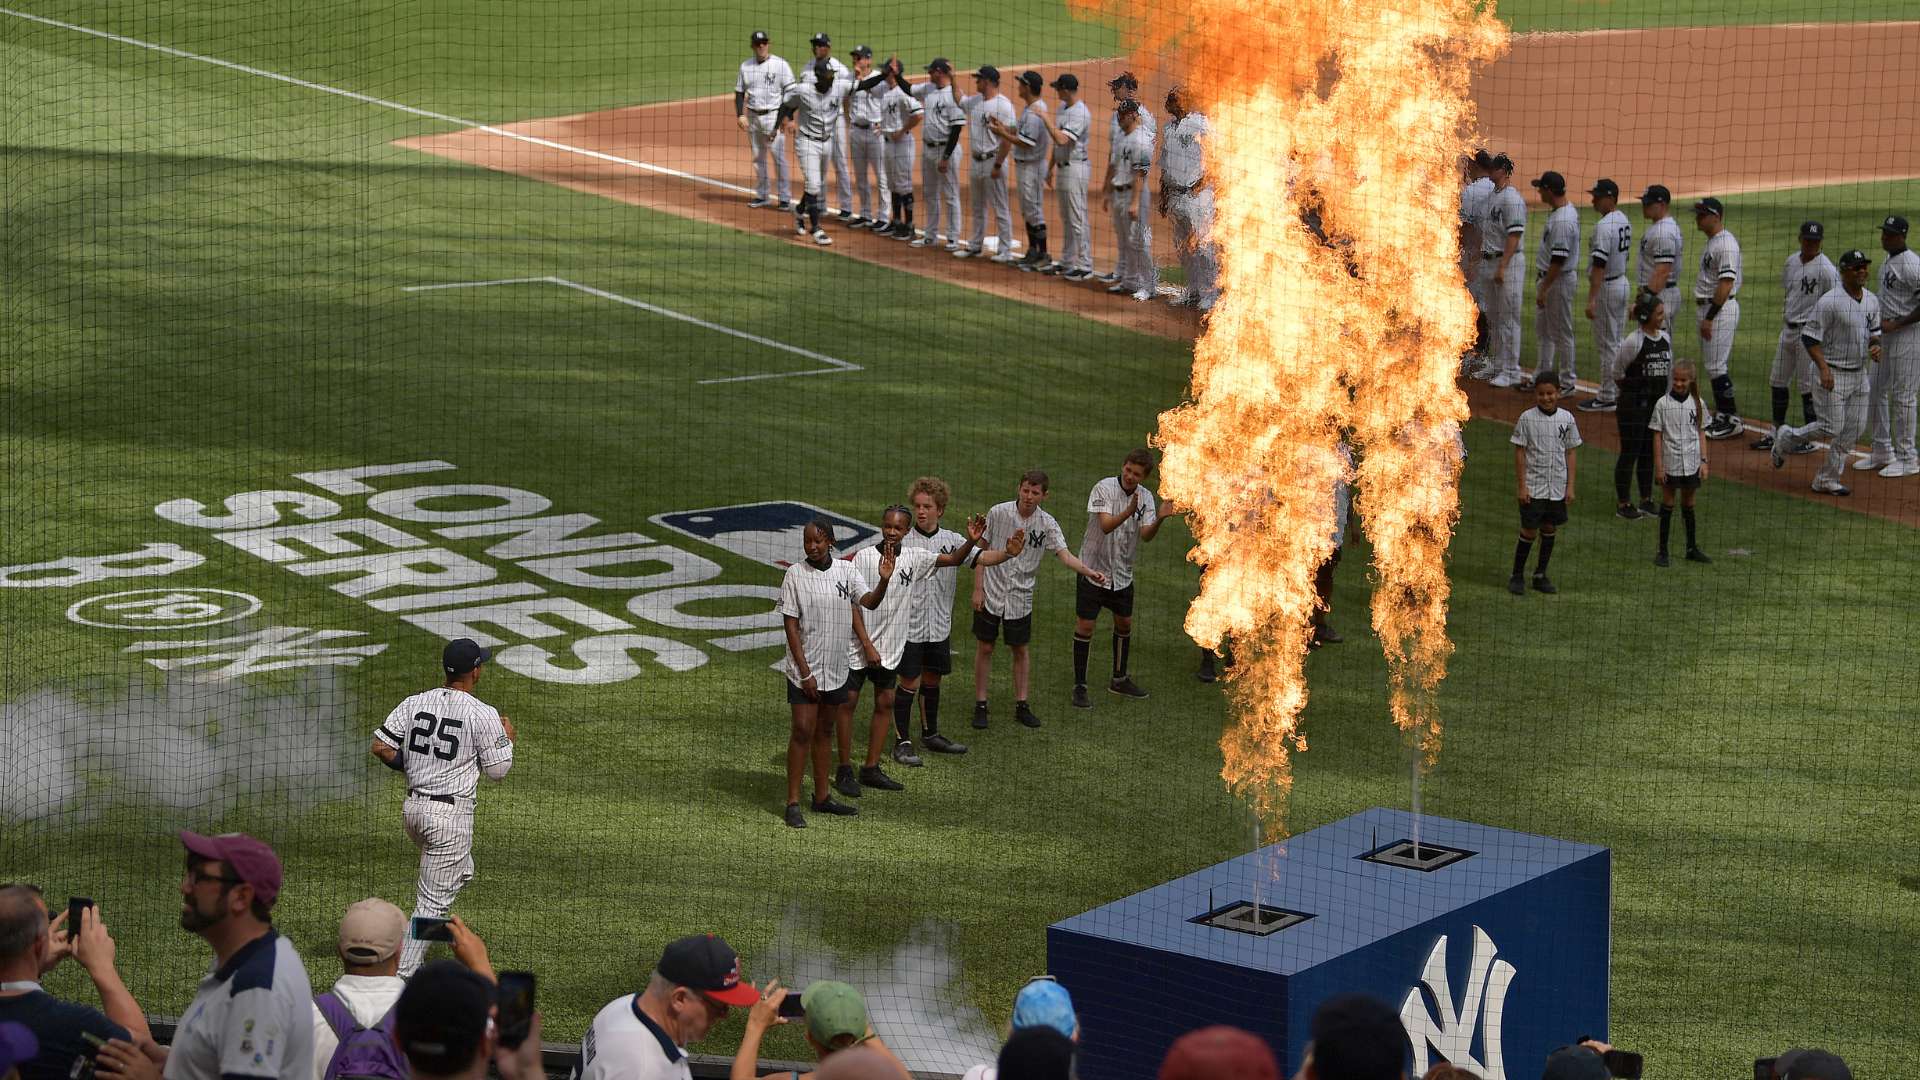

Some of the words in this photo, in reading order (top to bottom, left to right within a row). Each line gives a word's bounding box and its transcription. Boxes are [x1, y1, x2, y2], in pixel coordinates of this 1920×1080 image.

[1028, 529, 1047, 549] NY
[154, 489, 709, 686] SERIES
[835, 580, 855, 601] NY
[900, 567, 914, 588] NY
[121, 625, 390, 684] NY
[408, 710, 463, 762] 25
[1400, 924, 1517, 1080] NY
